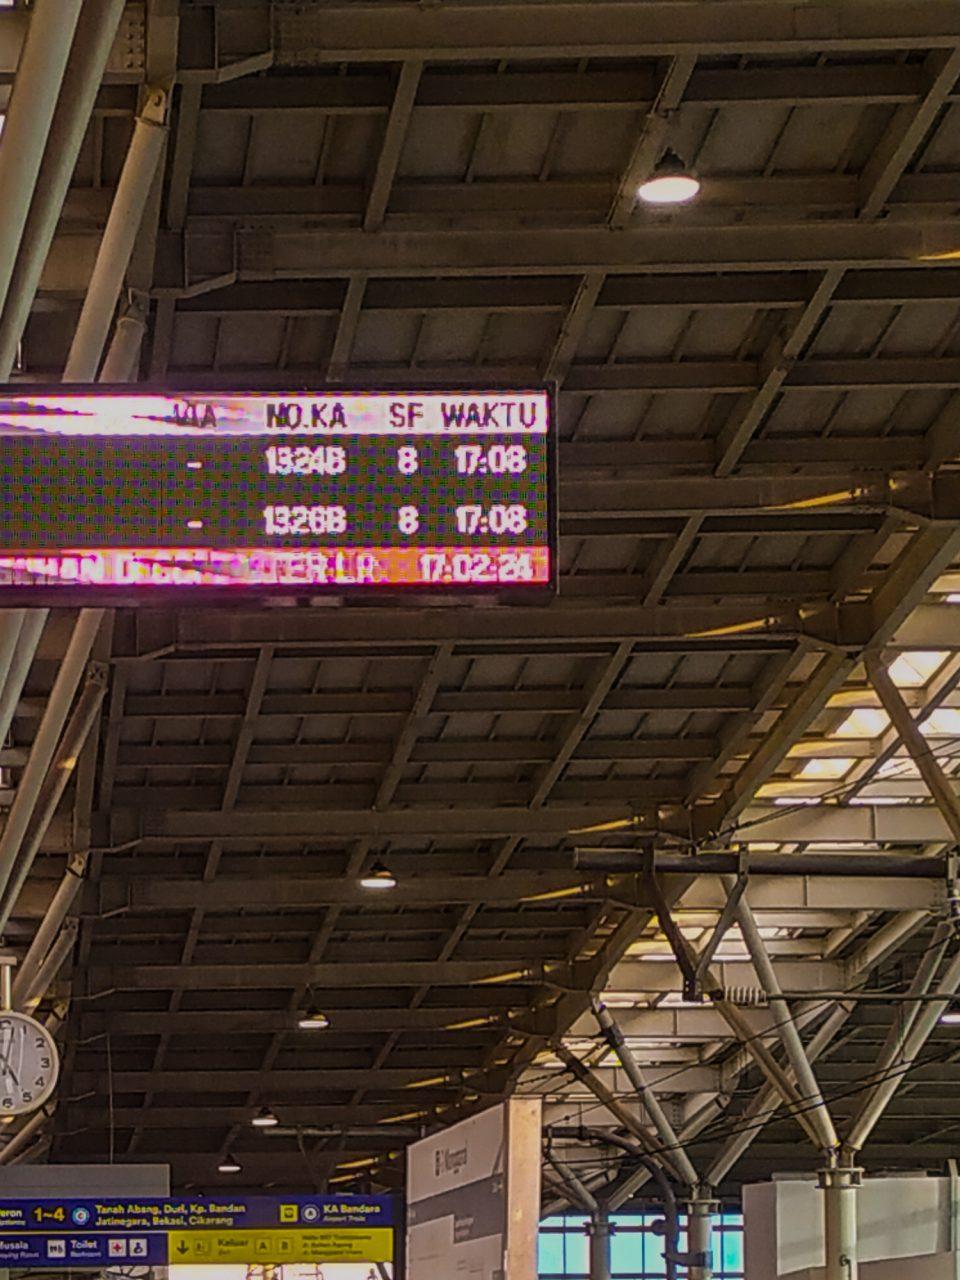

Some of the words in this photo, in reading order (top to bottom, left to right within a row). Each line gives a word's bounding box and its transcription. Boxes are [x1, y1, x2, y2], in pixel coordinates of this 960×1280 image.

[266, 402, 347, 428] NO.KA
[389, 402, 424, 428] SF
[441, 402, 537, 428] WAKTU
[397, 445, 419, 475] 8
[455, 444, 528, 475] 17:08
[397, 505, 419, 535] 8
[455, 504, 528, 535] 17:08
[35, 1037, 45, 1048] 2
[41, 1058, 50, 1069] 3
[35, 1077, 45, 1087] 4
[22, 1092, 32, 1102] 5
[2, 1098, 13, 1109] 6
[95, 1204, 124, 1214] Tanah
[209, 1204, 246, 1213] Bandan
[322, 1204, 338, 1213] KA
[341, 1204, 381, 1213] Bandara
[189, 1216, 233, 1226] Cikarang
[70, 1240, 97, 1249] Toilet
[218, 1238, 248, 1247] Keluar
